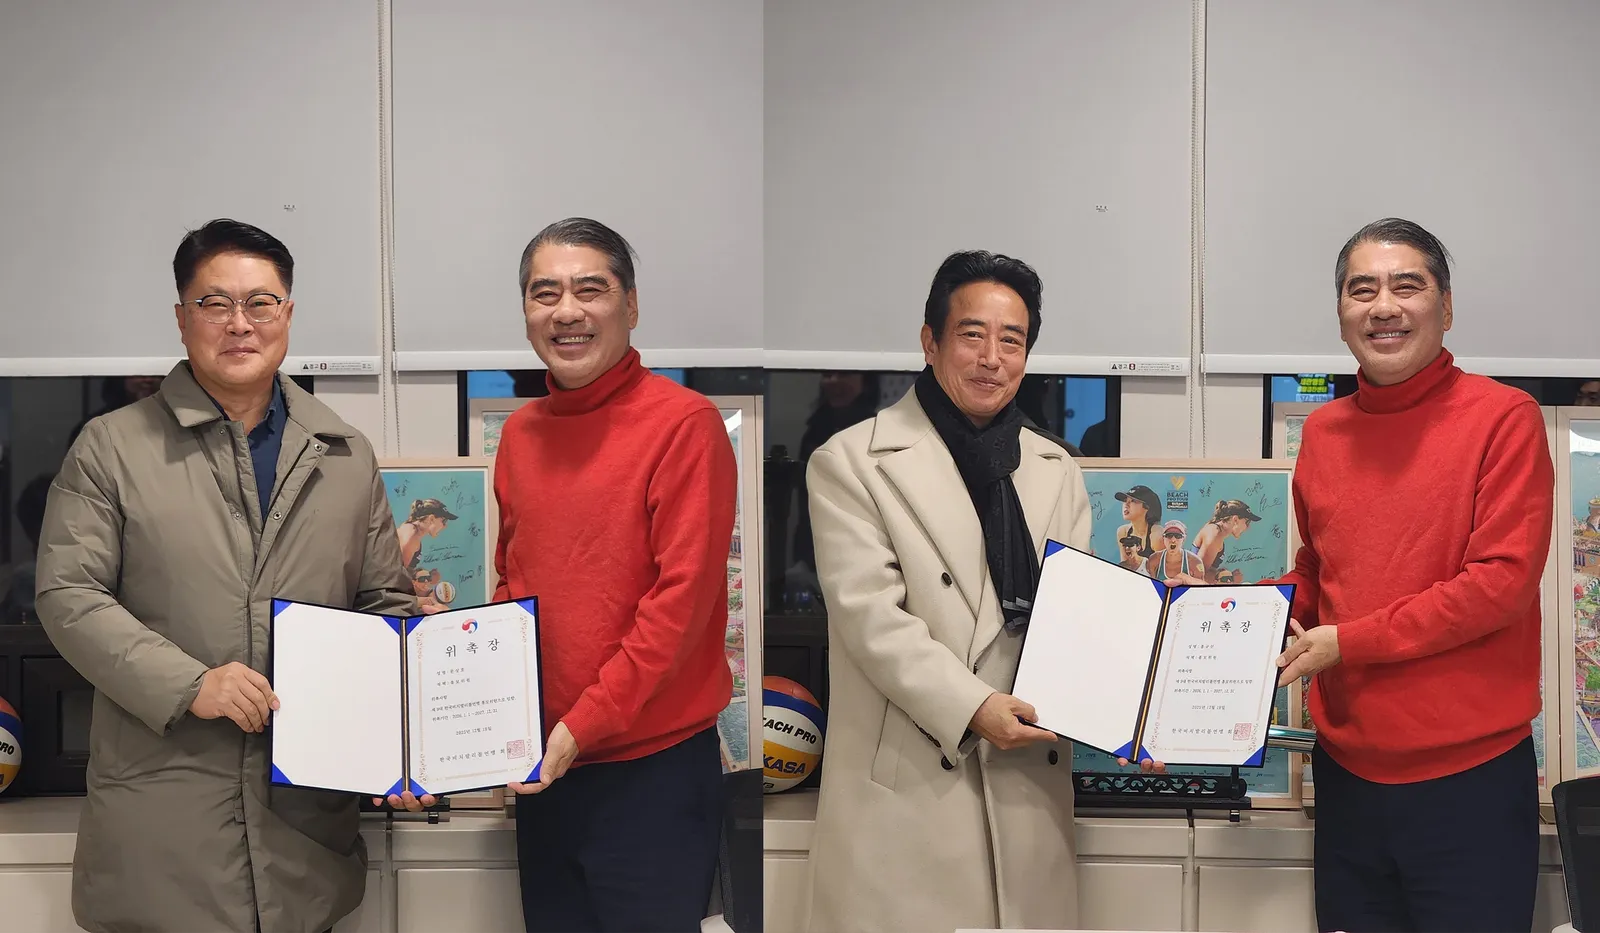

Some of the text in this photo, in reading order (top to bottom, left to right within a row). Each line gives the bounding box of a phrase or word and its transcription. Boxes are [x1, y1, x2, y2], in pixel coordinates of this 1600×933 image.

[763, 717, 817, 745] ACH PRO
[0, 740, 15, 756] RO
